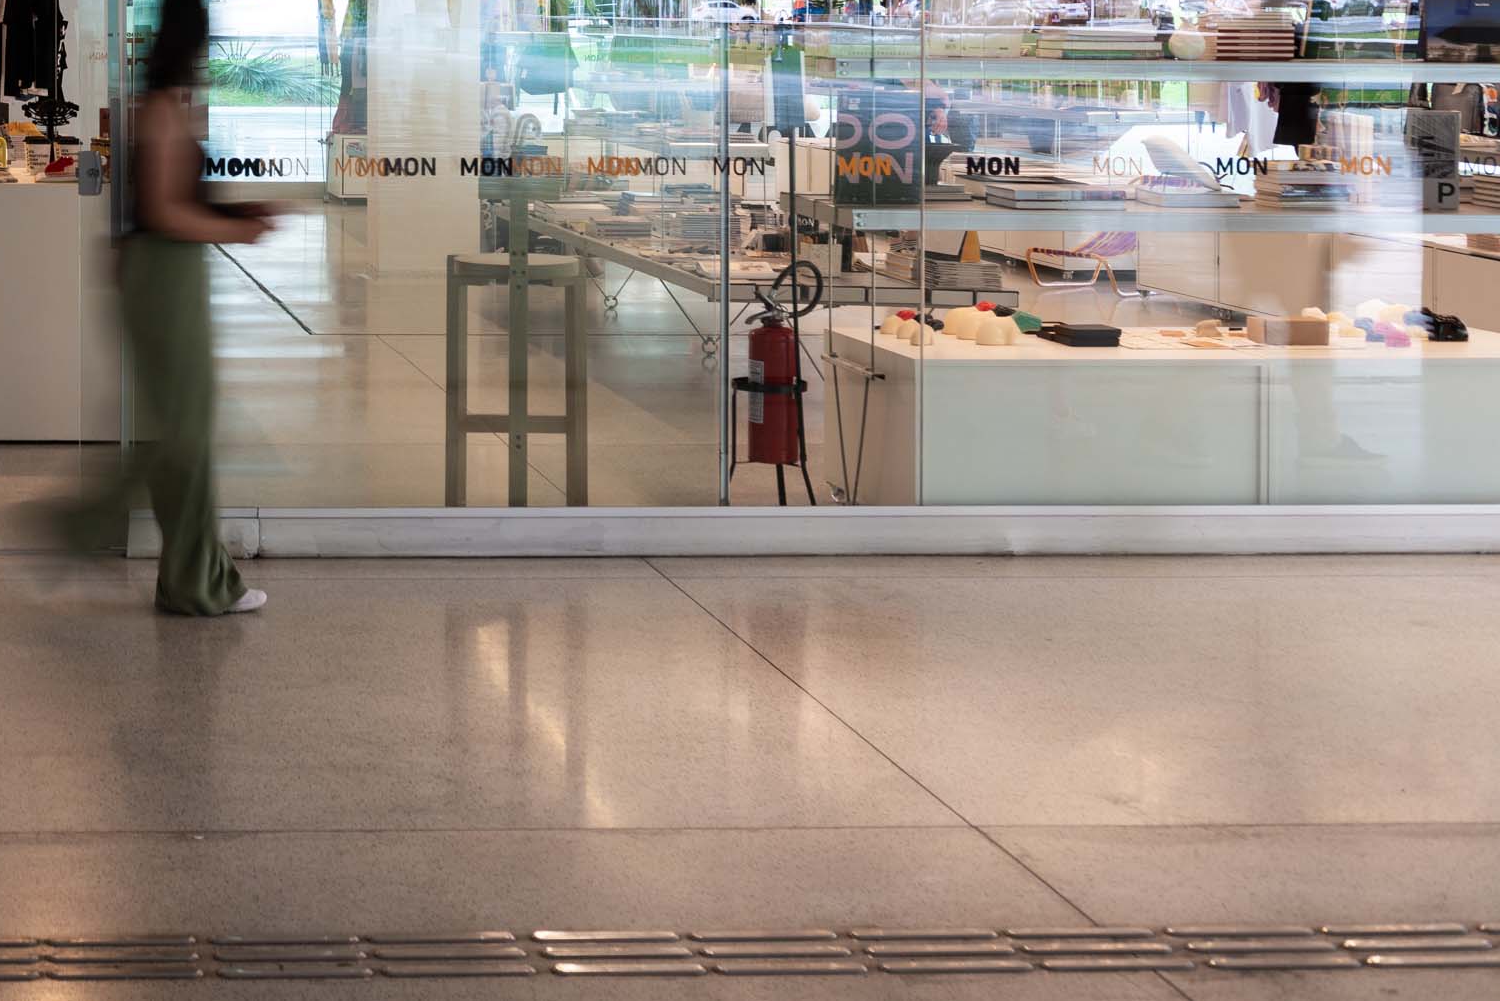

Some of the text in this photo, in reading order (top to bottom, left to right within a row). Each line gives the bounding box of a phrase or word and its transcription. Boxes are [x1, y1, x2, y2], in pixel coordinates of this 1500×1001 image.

[384, 157, 437, 176] MON
[460, 157, 513, 176] MON
[713, 156, 765, 175] MON
[837, 156, 892, 175] MON
[966, 156, 1020, 175] MON
[1093, 156, 1143, 175] MON
[1216, 156, 1268, 175] MON
[1341, 156, 1393, 175] MON
